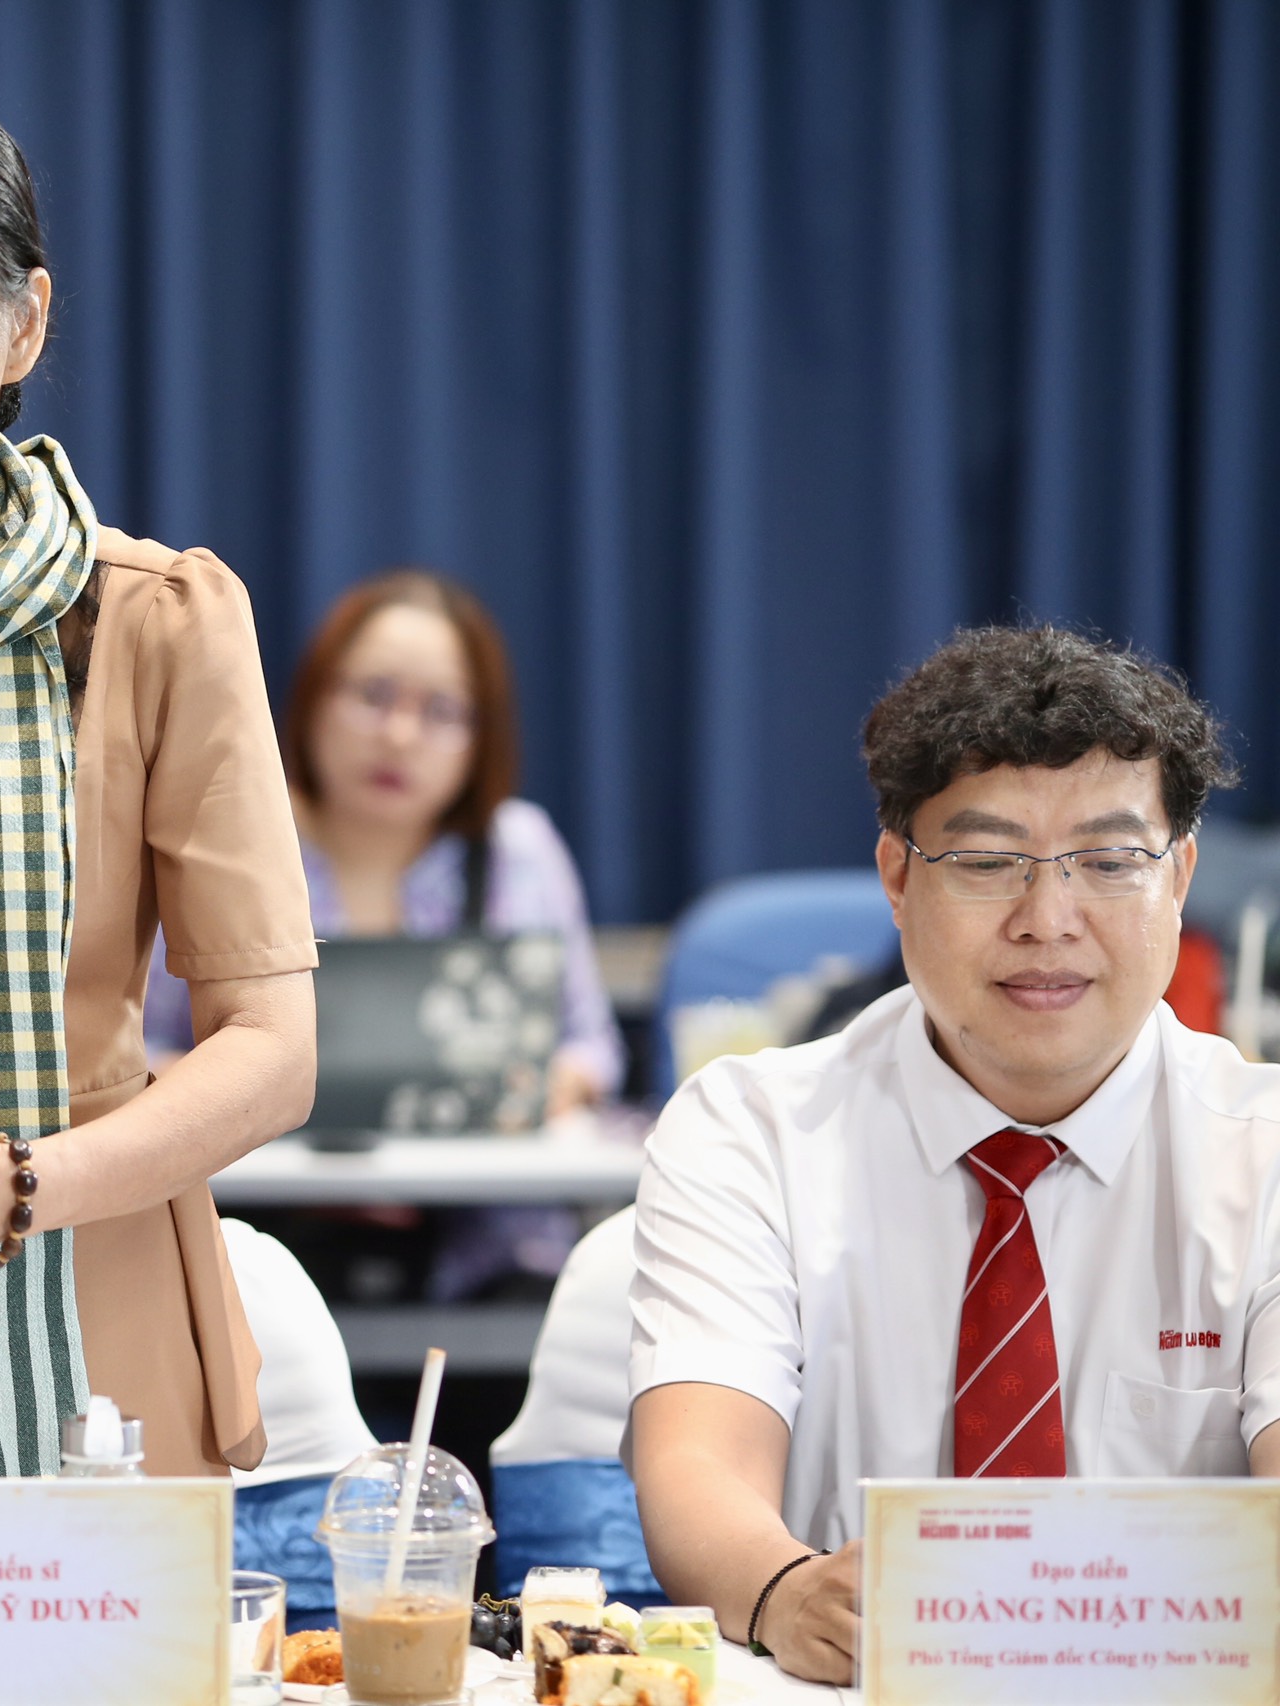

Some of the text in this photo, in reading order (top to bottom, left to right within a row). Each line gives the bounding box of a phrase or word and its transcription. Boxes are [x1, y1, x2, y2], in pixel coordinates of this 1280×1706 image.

[41, 1560, 62, 1581] sĩ
[1031, 1556, 1128, 1581] Đạo diễn
[31, 1592, 141, 1622] DUYÊN
[915, 1592, 1043, 1623] HOÀNG
[1163, 1598, 1244, 1622] NAM
[908, 1648, 944, 1666] Phó
[999, 1648, 1048, 1666] Giám
[1054, 1647, 1084, 1666] đốc
[1089, 1649, 1137, 1668] Công
[1143, 1651, 1158, 1669] ty
[1164, 1650, 1198, 1666] Sen
[1202, 1648, 1250, 1668] Vàng
